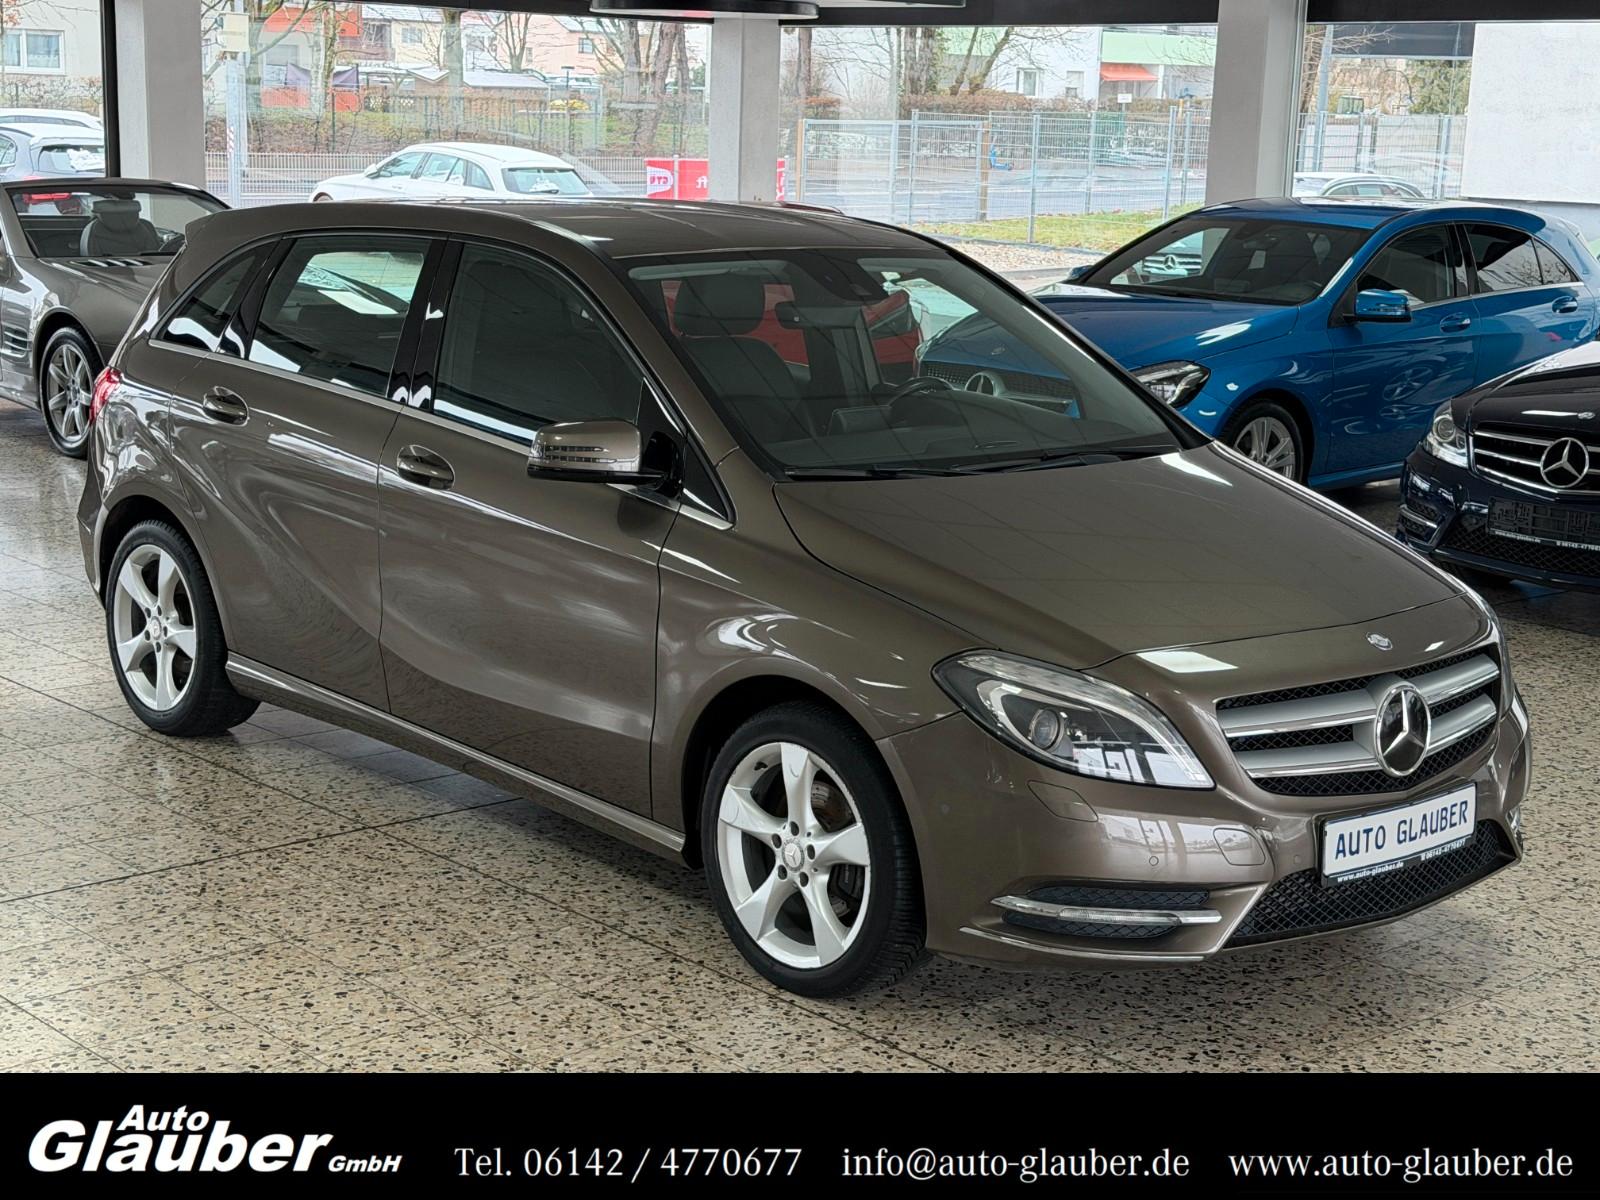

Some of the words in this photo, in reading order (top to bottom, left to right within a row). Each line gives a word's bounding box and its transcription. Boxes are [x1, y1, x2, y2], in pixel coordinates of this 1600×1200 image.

[1335, 825, 1386, 860] AUTO
[1397, 800, 1468, 844] GLAUBER
[1337, 861, 1404, 882] www.auto-glauber.de
